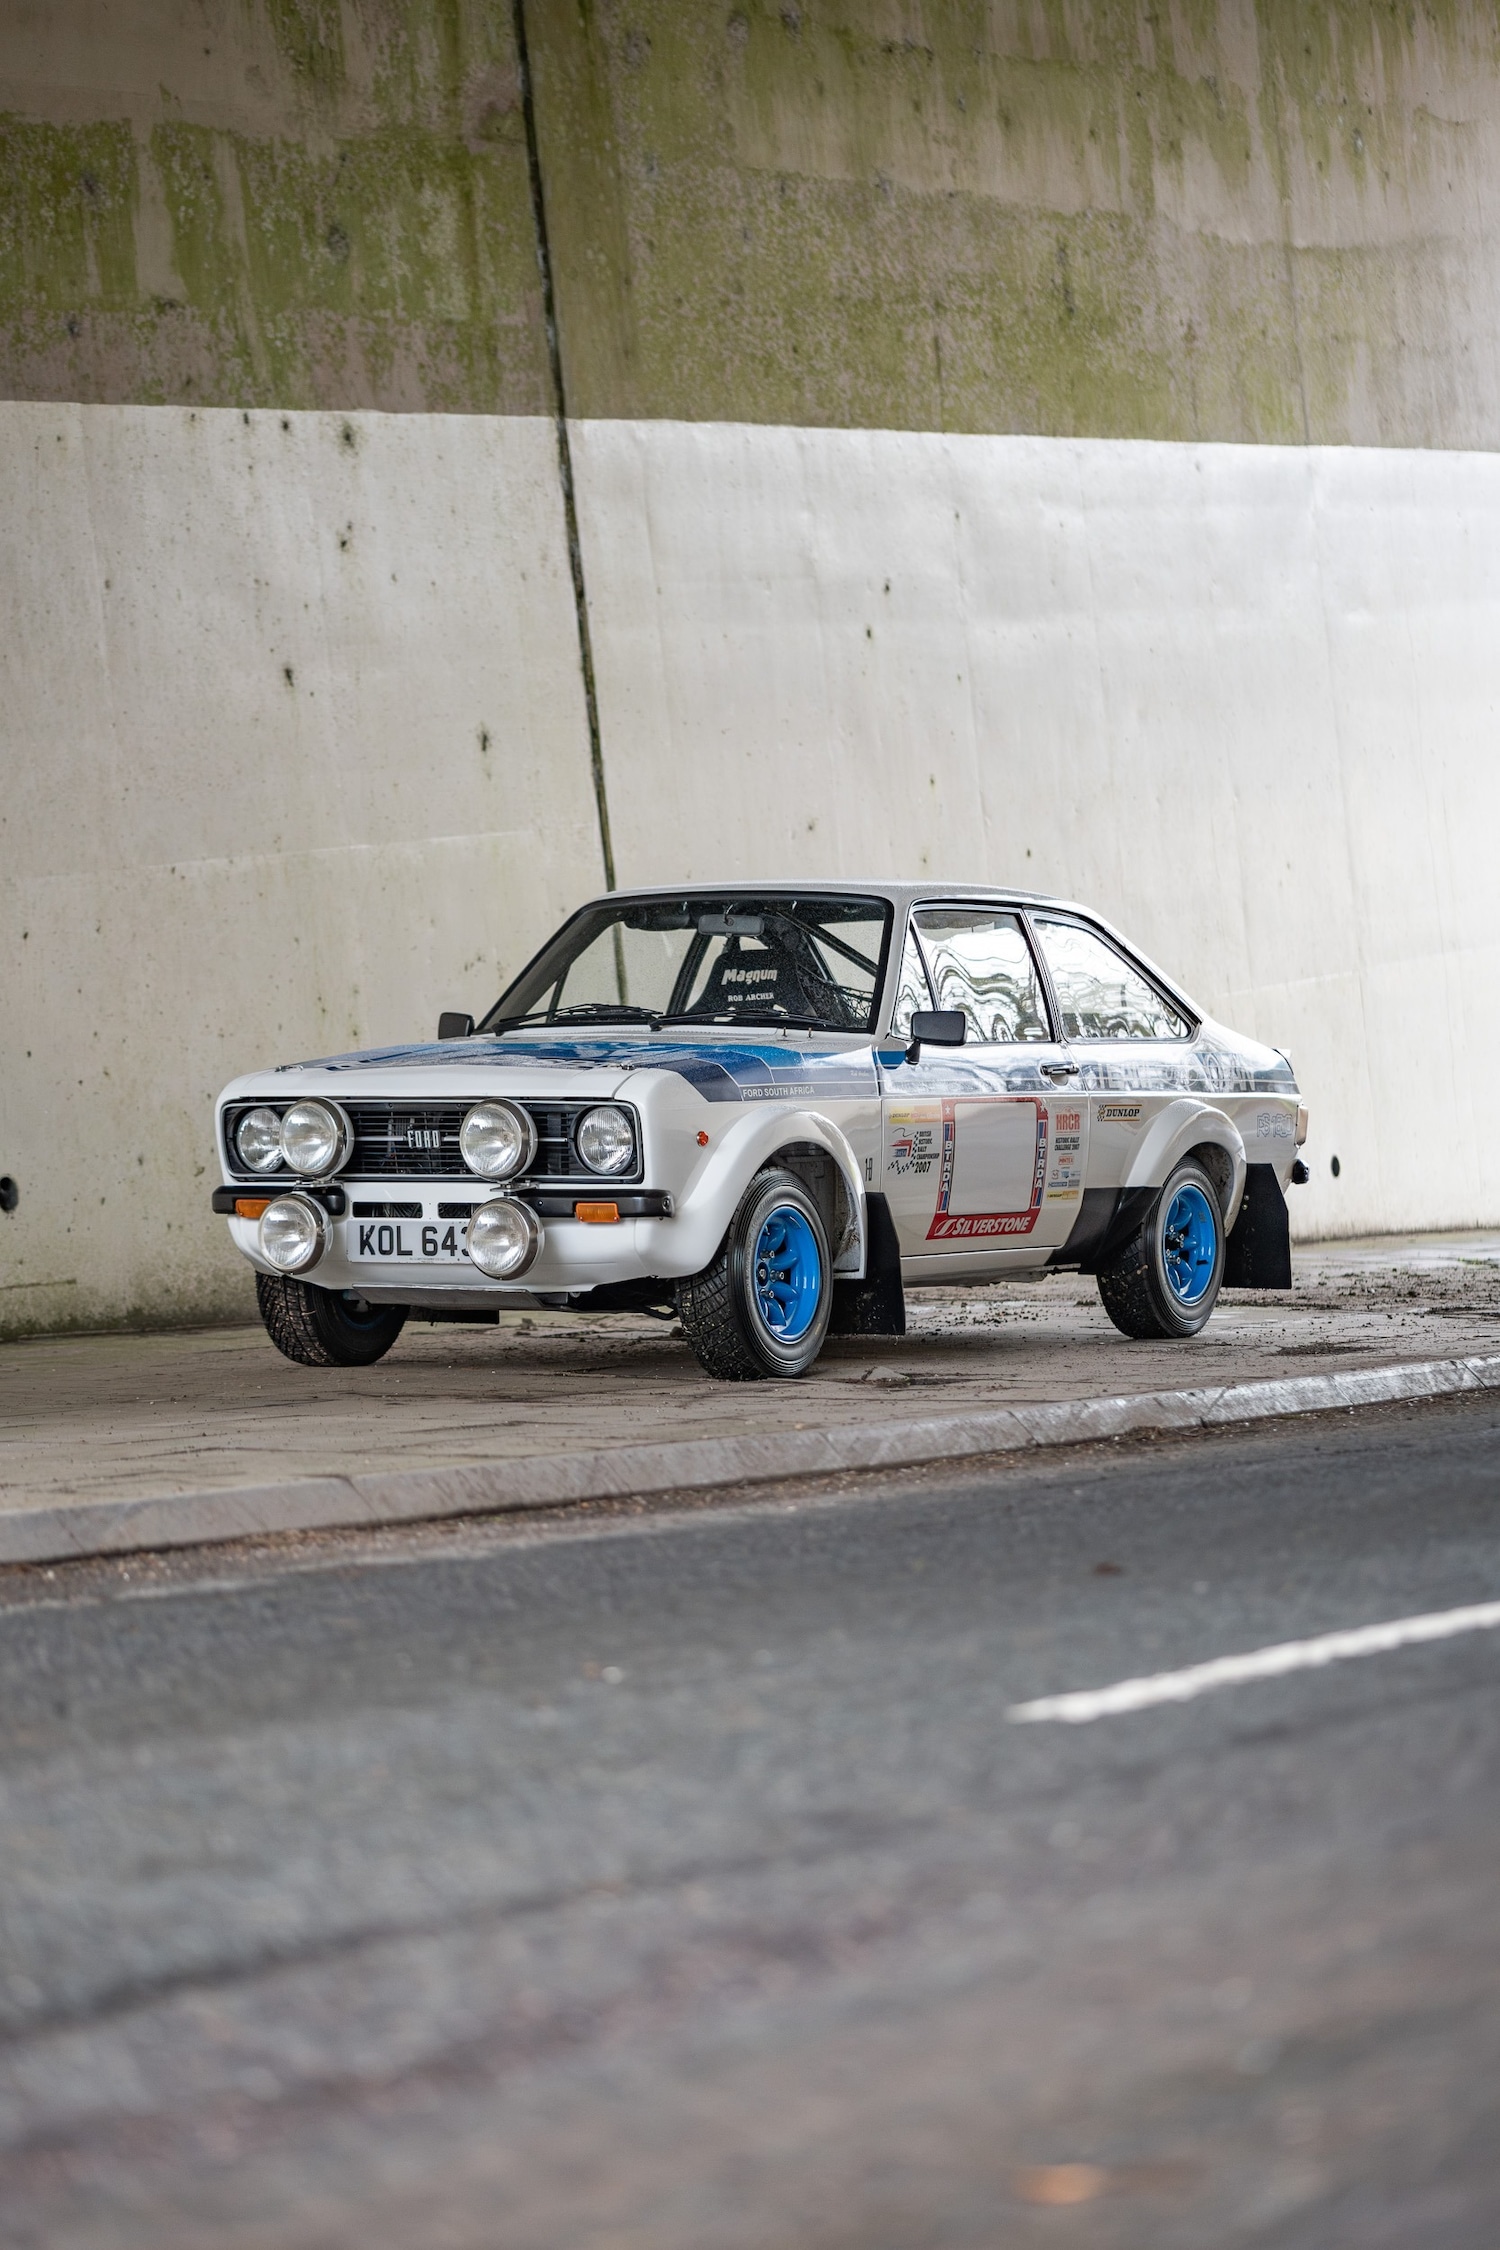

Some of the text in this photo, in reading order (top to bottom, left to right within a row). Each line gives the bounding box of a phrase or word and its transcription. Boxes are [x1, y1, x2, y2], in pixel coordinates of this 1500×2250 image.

[720, 968, 778, 985] Magnum
[727, 992, 775, 1002] ROB ARCHER
[743, 1085, 815, 1098] FORD SOUTH AFRICA
[1106, 1108, 1140, 1117] DUNLOP
[1056, 1114, 1080, 1131] HRCR
[1256, 1113, 1271, 1138] RS
[408, 1130, 440, 1148] FORD
[914, 1160, 932, 1174] 2007
[941, 1141, 954, 1192] BTRDA
[1034, 1138, 1047, 1188] BTRDA
[953, 1216, 1032, 1236] SILVERSTONE
[359, 1225, 413, 1256] KOL
